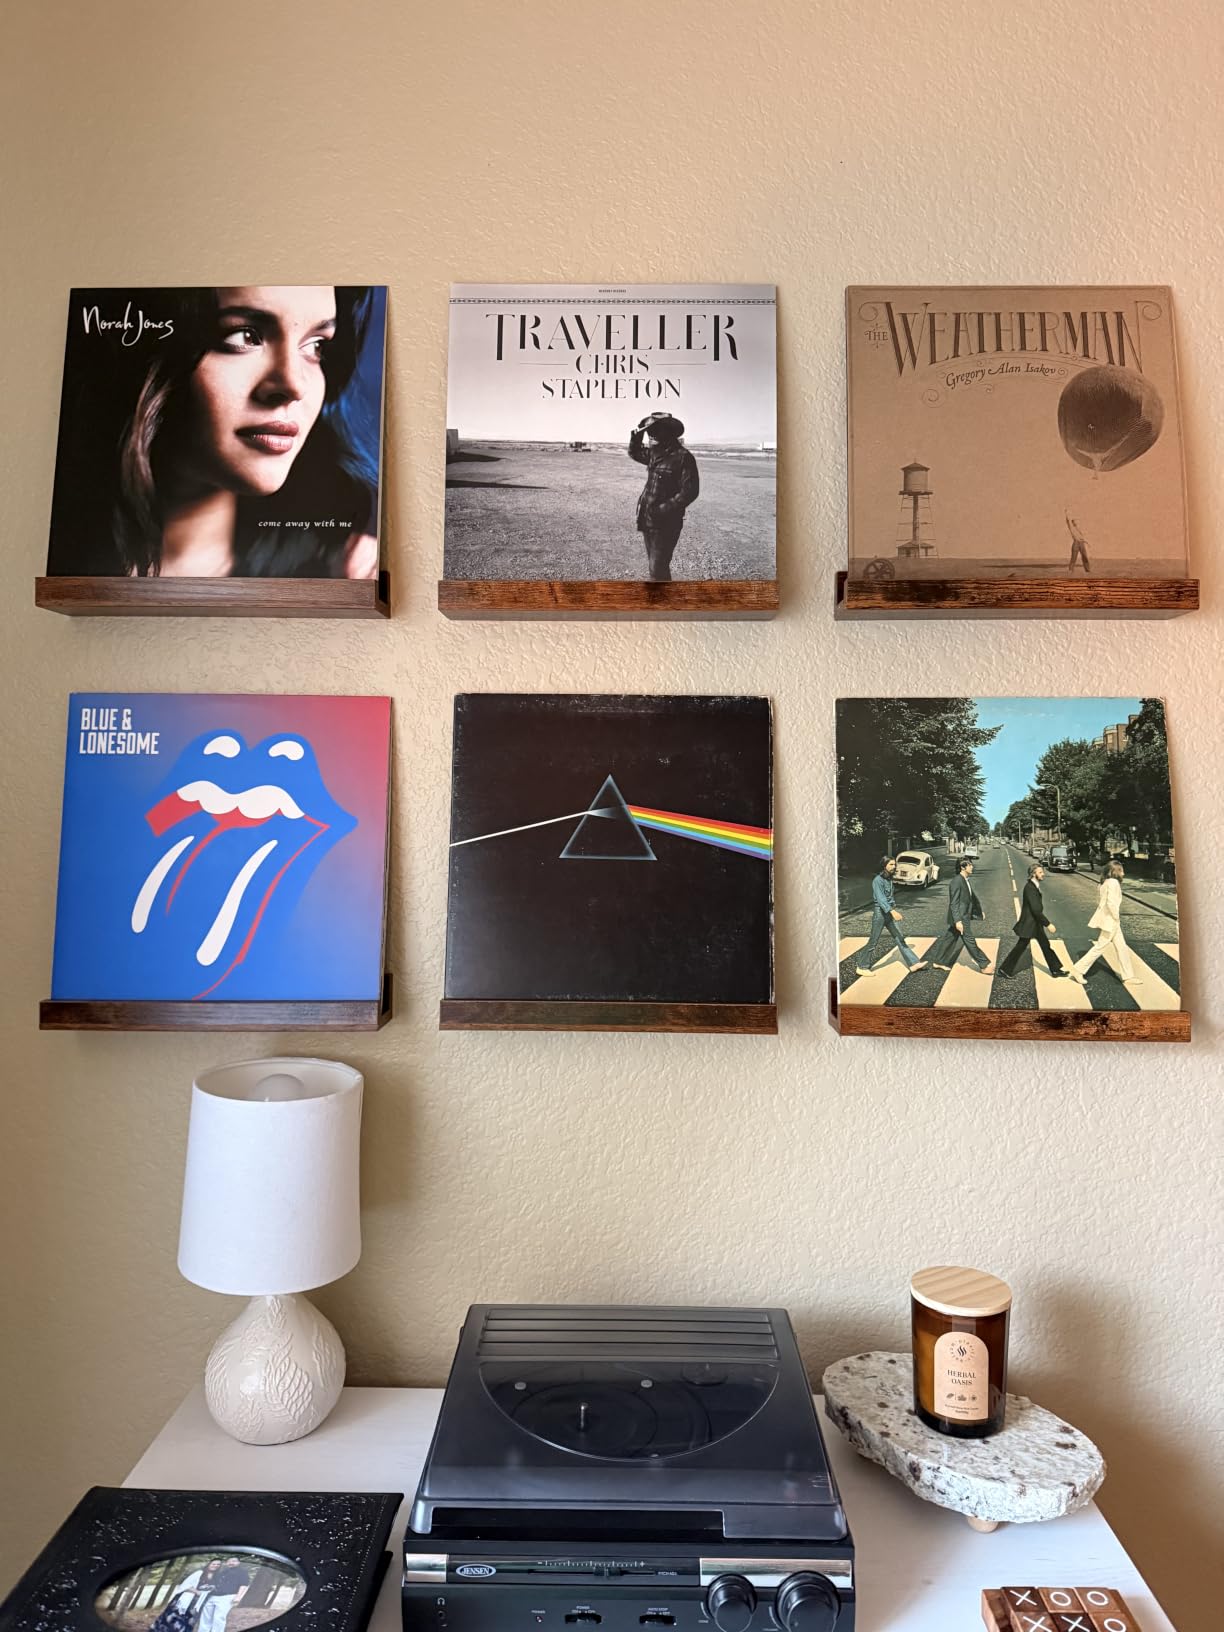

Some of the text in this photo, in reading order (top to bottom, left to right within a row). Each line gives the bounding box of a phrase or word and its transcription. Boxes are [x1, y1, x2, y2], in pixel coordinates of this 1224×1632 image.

[82, 301, 174, 347] Norah Jones
[485, 314, 739, 361] TRAVELLER
[858, 300, 1162, 376] THE WEATHERMAN
[575, 354, 649, 374] CHRIS
[945, 362, 1057, 389] Gregory Alan Isakov
[541, 378, 681, 399] STAPLETON
[285, 520, 310, 530] away
[314, 518, 335, 528] with
[81, 708, 132, 730] BLUE &
[79, 731, 160, 754] LONESOME
[947, 1369, 976, 1379] HERBAL
[951, 1378, 973, 1386] OASIS
[461, 1567, 490, 1575] JENSEN
